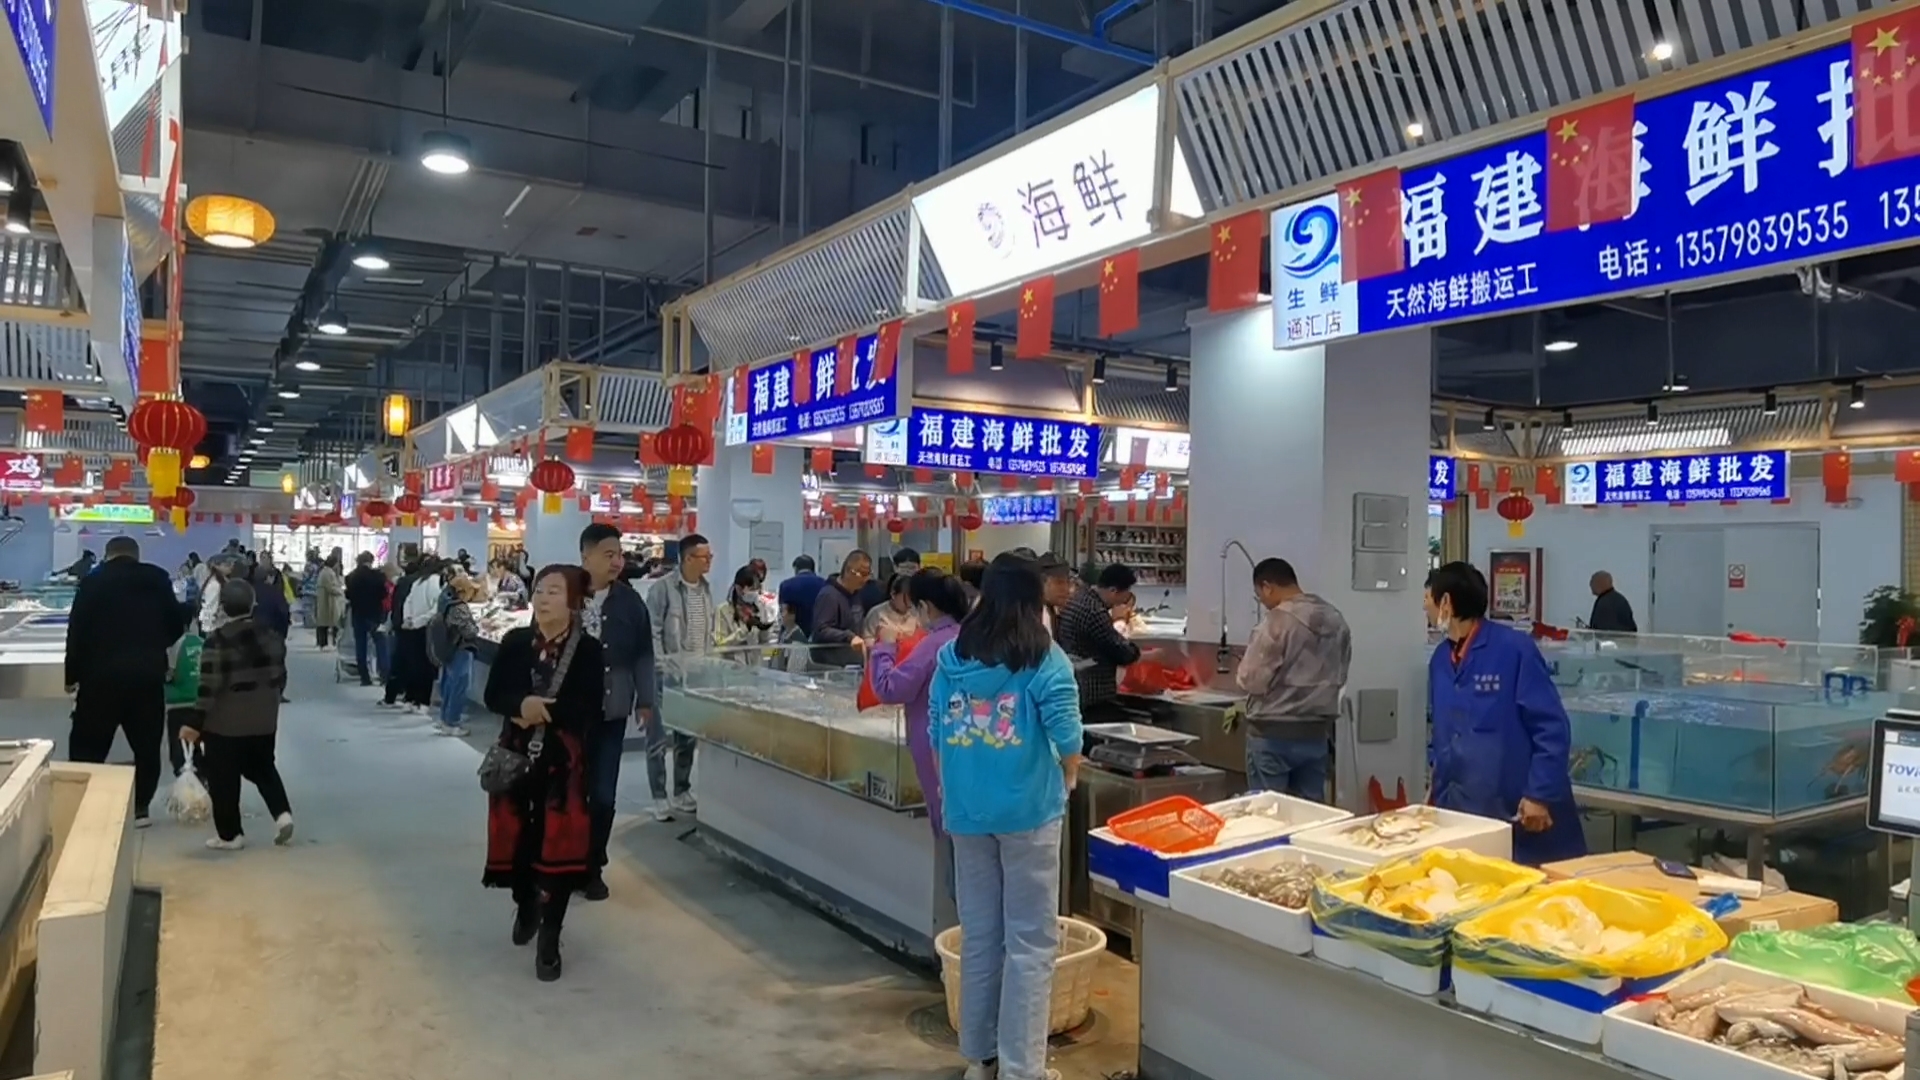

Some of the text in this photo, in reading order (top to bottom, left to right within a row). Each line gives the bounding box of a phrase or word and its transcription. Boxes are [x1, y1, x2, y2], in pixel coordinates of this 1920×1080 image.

[1017, 149, 1127, 248] 海鲜
[1675, 200, 1849, 269] 13579839535
[1287, 280, 1338, 311] 生鲜
[1387, 262, 1539, 320] 天然海鲜搬运工
[1287, 311, 1342, 341] 通汇店
[919, 412, 1090, 459] 福建海鲜批发
[1604, 454, 1775, 489] 福建海鲜批发
